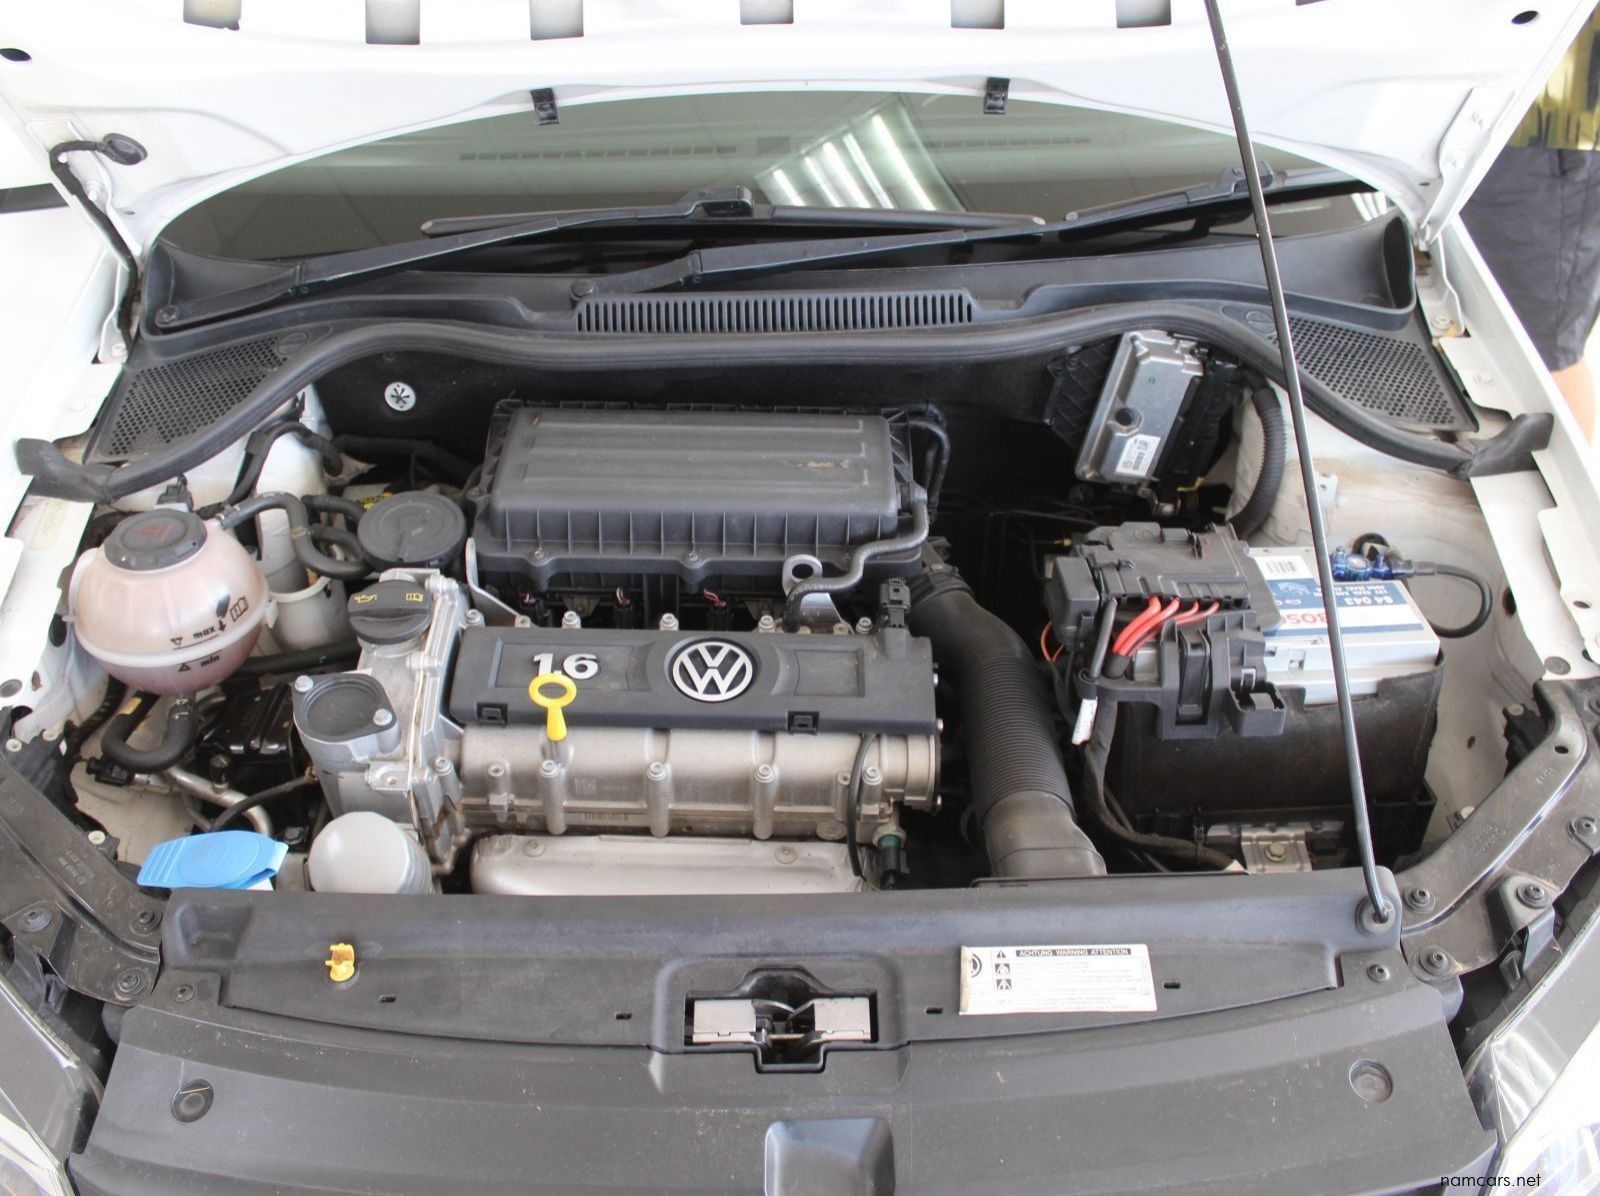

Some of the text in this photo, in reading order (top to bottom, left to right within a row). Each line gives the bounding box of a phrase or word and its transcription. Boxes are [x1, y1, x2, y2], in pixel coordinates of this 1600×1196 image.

[193, 626, 215, 638] max
[201, 655, 219, 666] min
[1019, 947, 1129, 957] ACHTUNG WARNING ATTENTION
